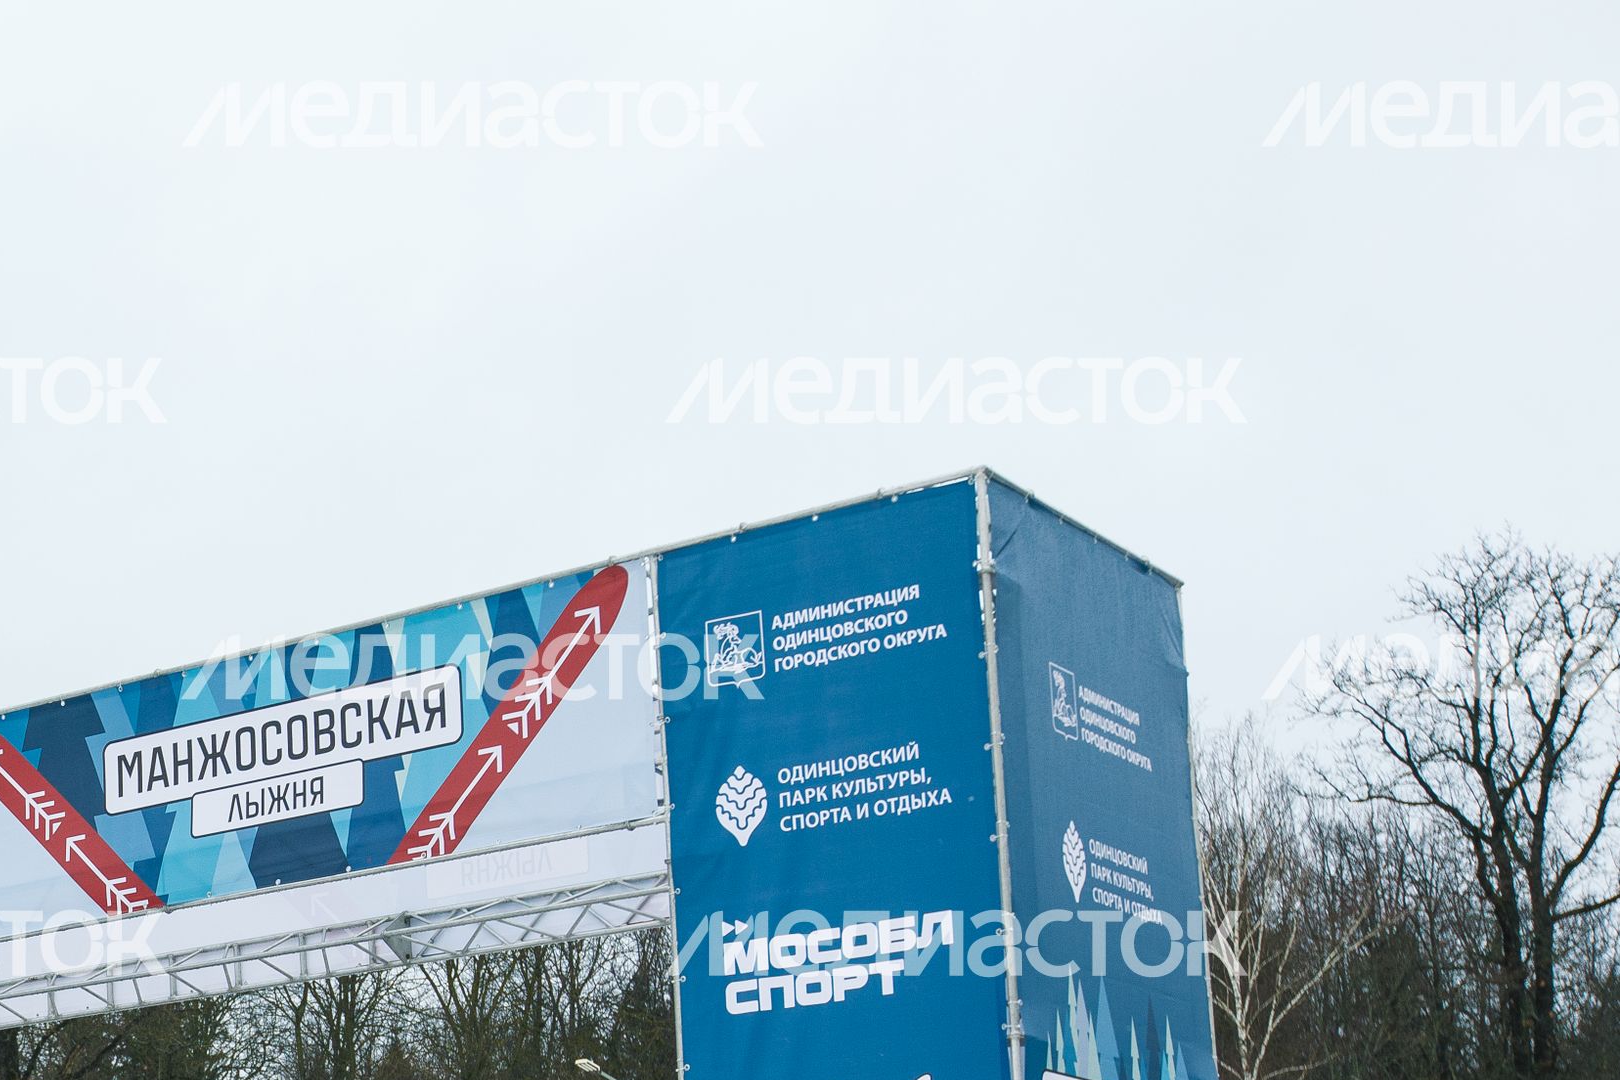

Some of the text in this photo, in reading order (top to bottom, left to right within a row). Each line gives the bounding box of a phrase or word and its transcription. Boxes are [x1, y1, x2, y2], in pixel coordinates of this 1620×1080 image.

[771, 583, 920, 631] АДМИНИСТРАЦИЯ
[772, 609, 908, 652] ОДИНЦОВСКОГО
[774, 623, 947, 672] ГОРОДСКОГО ОКРУГА
[1078, 685, 1140, 727] АДМИНИСТРАЦИЯ
[1079, 706, 1137, 745] ОДИНЦОВСКОГО
[115, 682, 448, 798] МАНЖОСОВСКАЯ
[778, 740, 920, 785] ОДИНЦОВСКИЙ
[1081, 728, 1153, 773] ГОРОДСКОГО ОКРУГА
[226, 777, 325, 824] ЛЫЖНЯ
[779, 767, 932, 808] ПАРК КУЛЬТУРЫ,
[780, 787, 953, 832] СПОРТА И ОТДЫХА
[1088, 838, 1149, 876] ОДИНЦОВСКИЙ
[1090, 862, 1155, 902] ПАРК КУЛЬТУРЫ,
[1092, 886, 1163, 926] СПОРТА И ОТДЫХА
[723, 909, 954, 976] МОСОБЛ
[725, 958, 905, 1015] СПОРТ
